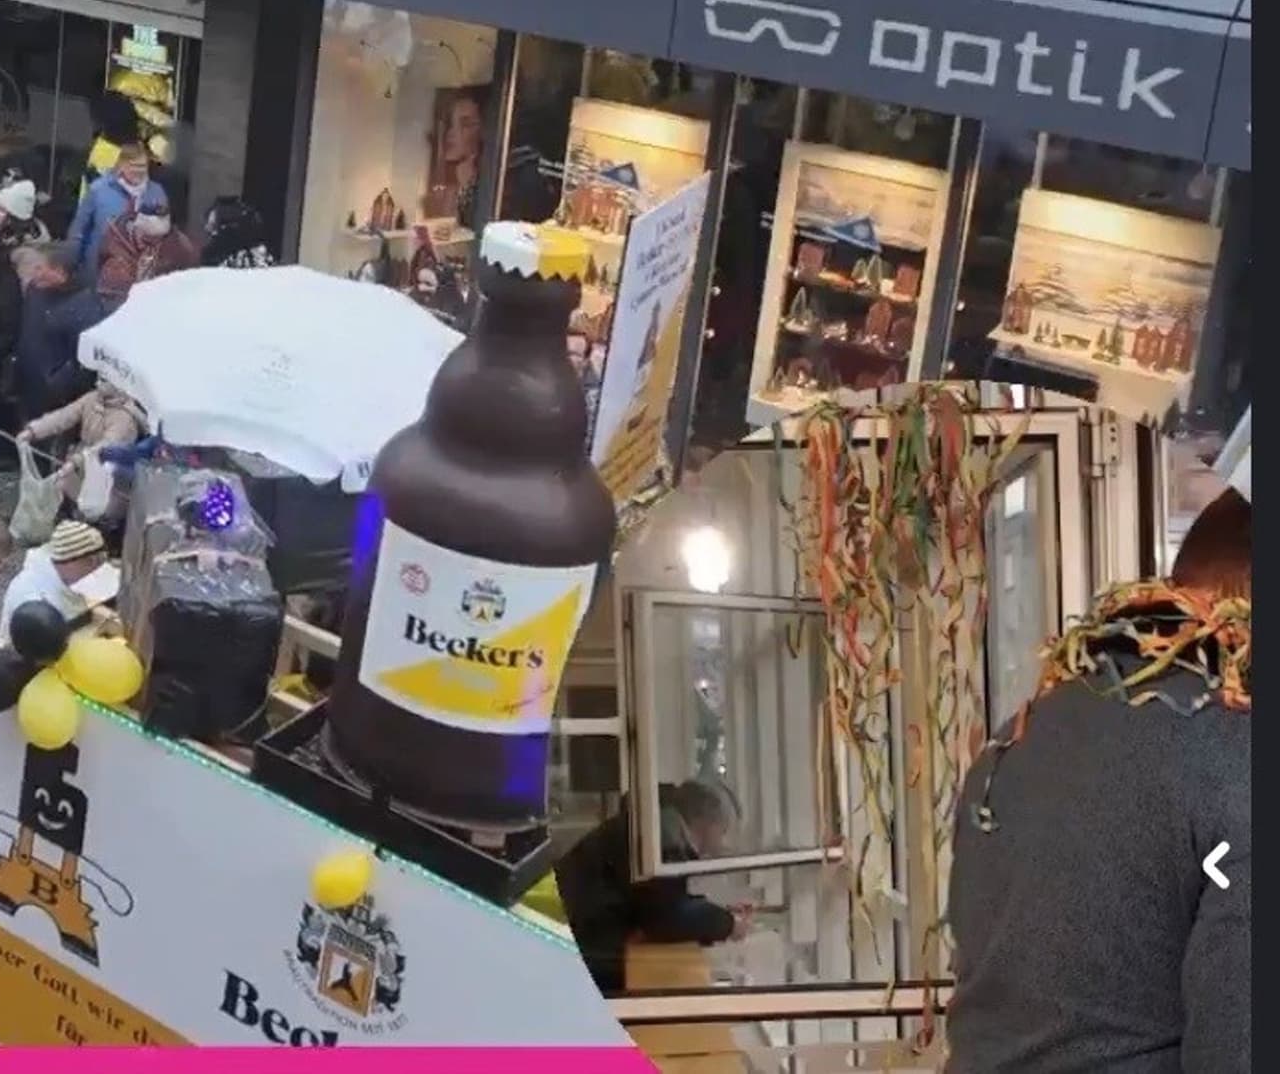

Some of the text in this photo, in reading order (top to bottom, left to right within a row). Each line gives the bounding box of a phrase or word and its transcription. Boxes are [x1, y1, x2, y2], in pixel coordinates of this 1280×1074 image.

[868, 19, 1185, 120] optik
[403, 612, 544, 670] Becker's
[29, 870, 60, 907] B
[32, 962, 80, 1006] Gott
[87, 999, 126, 1031] wir
